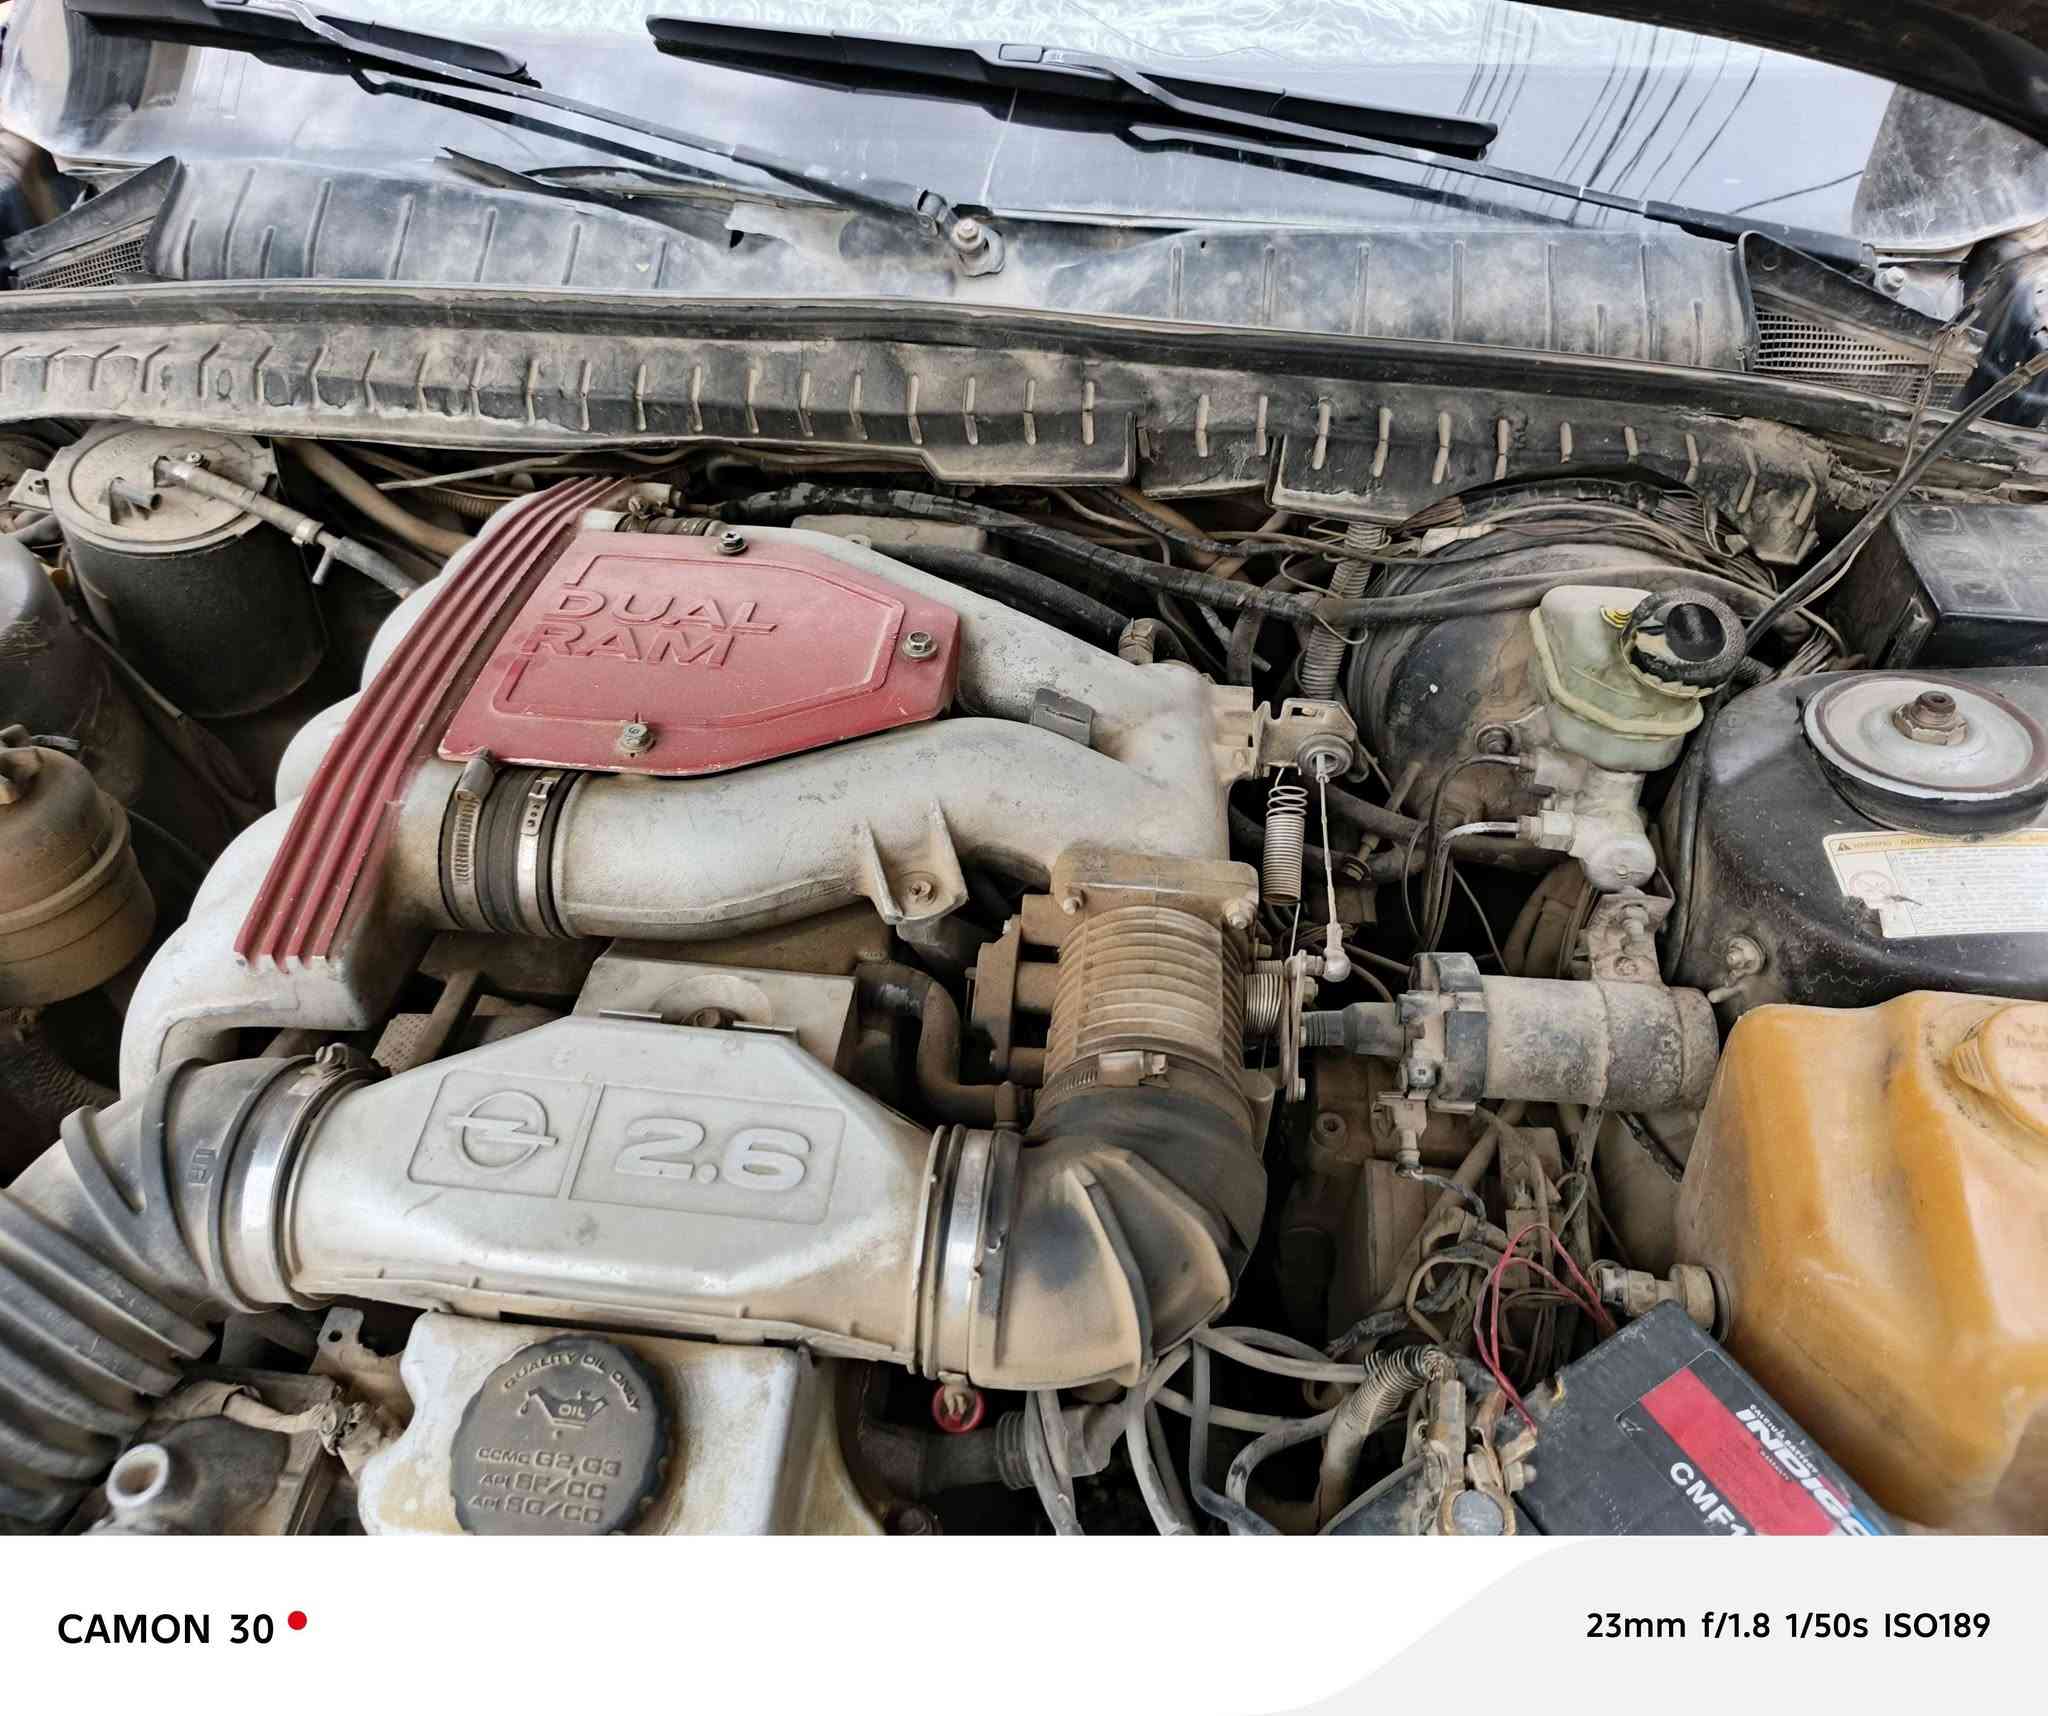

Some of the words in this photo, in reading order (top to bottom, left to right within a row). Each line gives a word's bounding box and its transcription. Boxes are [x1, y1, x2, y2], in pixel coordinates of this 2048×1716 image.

[543, 587, 777, 634] DUAL
[521, 621, 735, 669] RAM
[615, 1116, 812, 1192] 2.6
[501, 1352, 577, 1393] QUALITY
[580, 1353, 607, 1375] OIL
[609, 1369, 641, 1414] ONLY
[558, 1403, 586, 1417] OIL
[477, 1448, 530, 1465] CCMC
[534, 1449, 622, 1477] G2,G3
[1784, 1439, 1819, 1474] BATTERY
[480, 1472, 511, 1489] API
[468, 1495, 502, 1512] API
